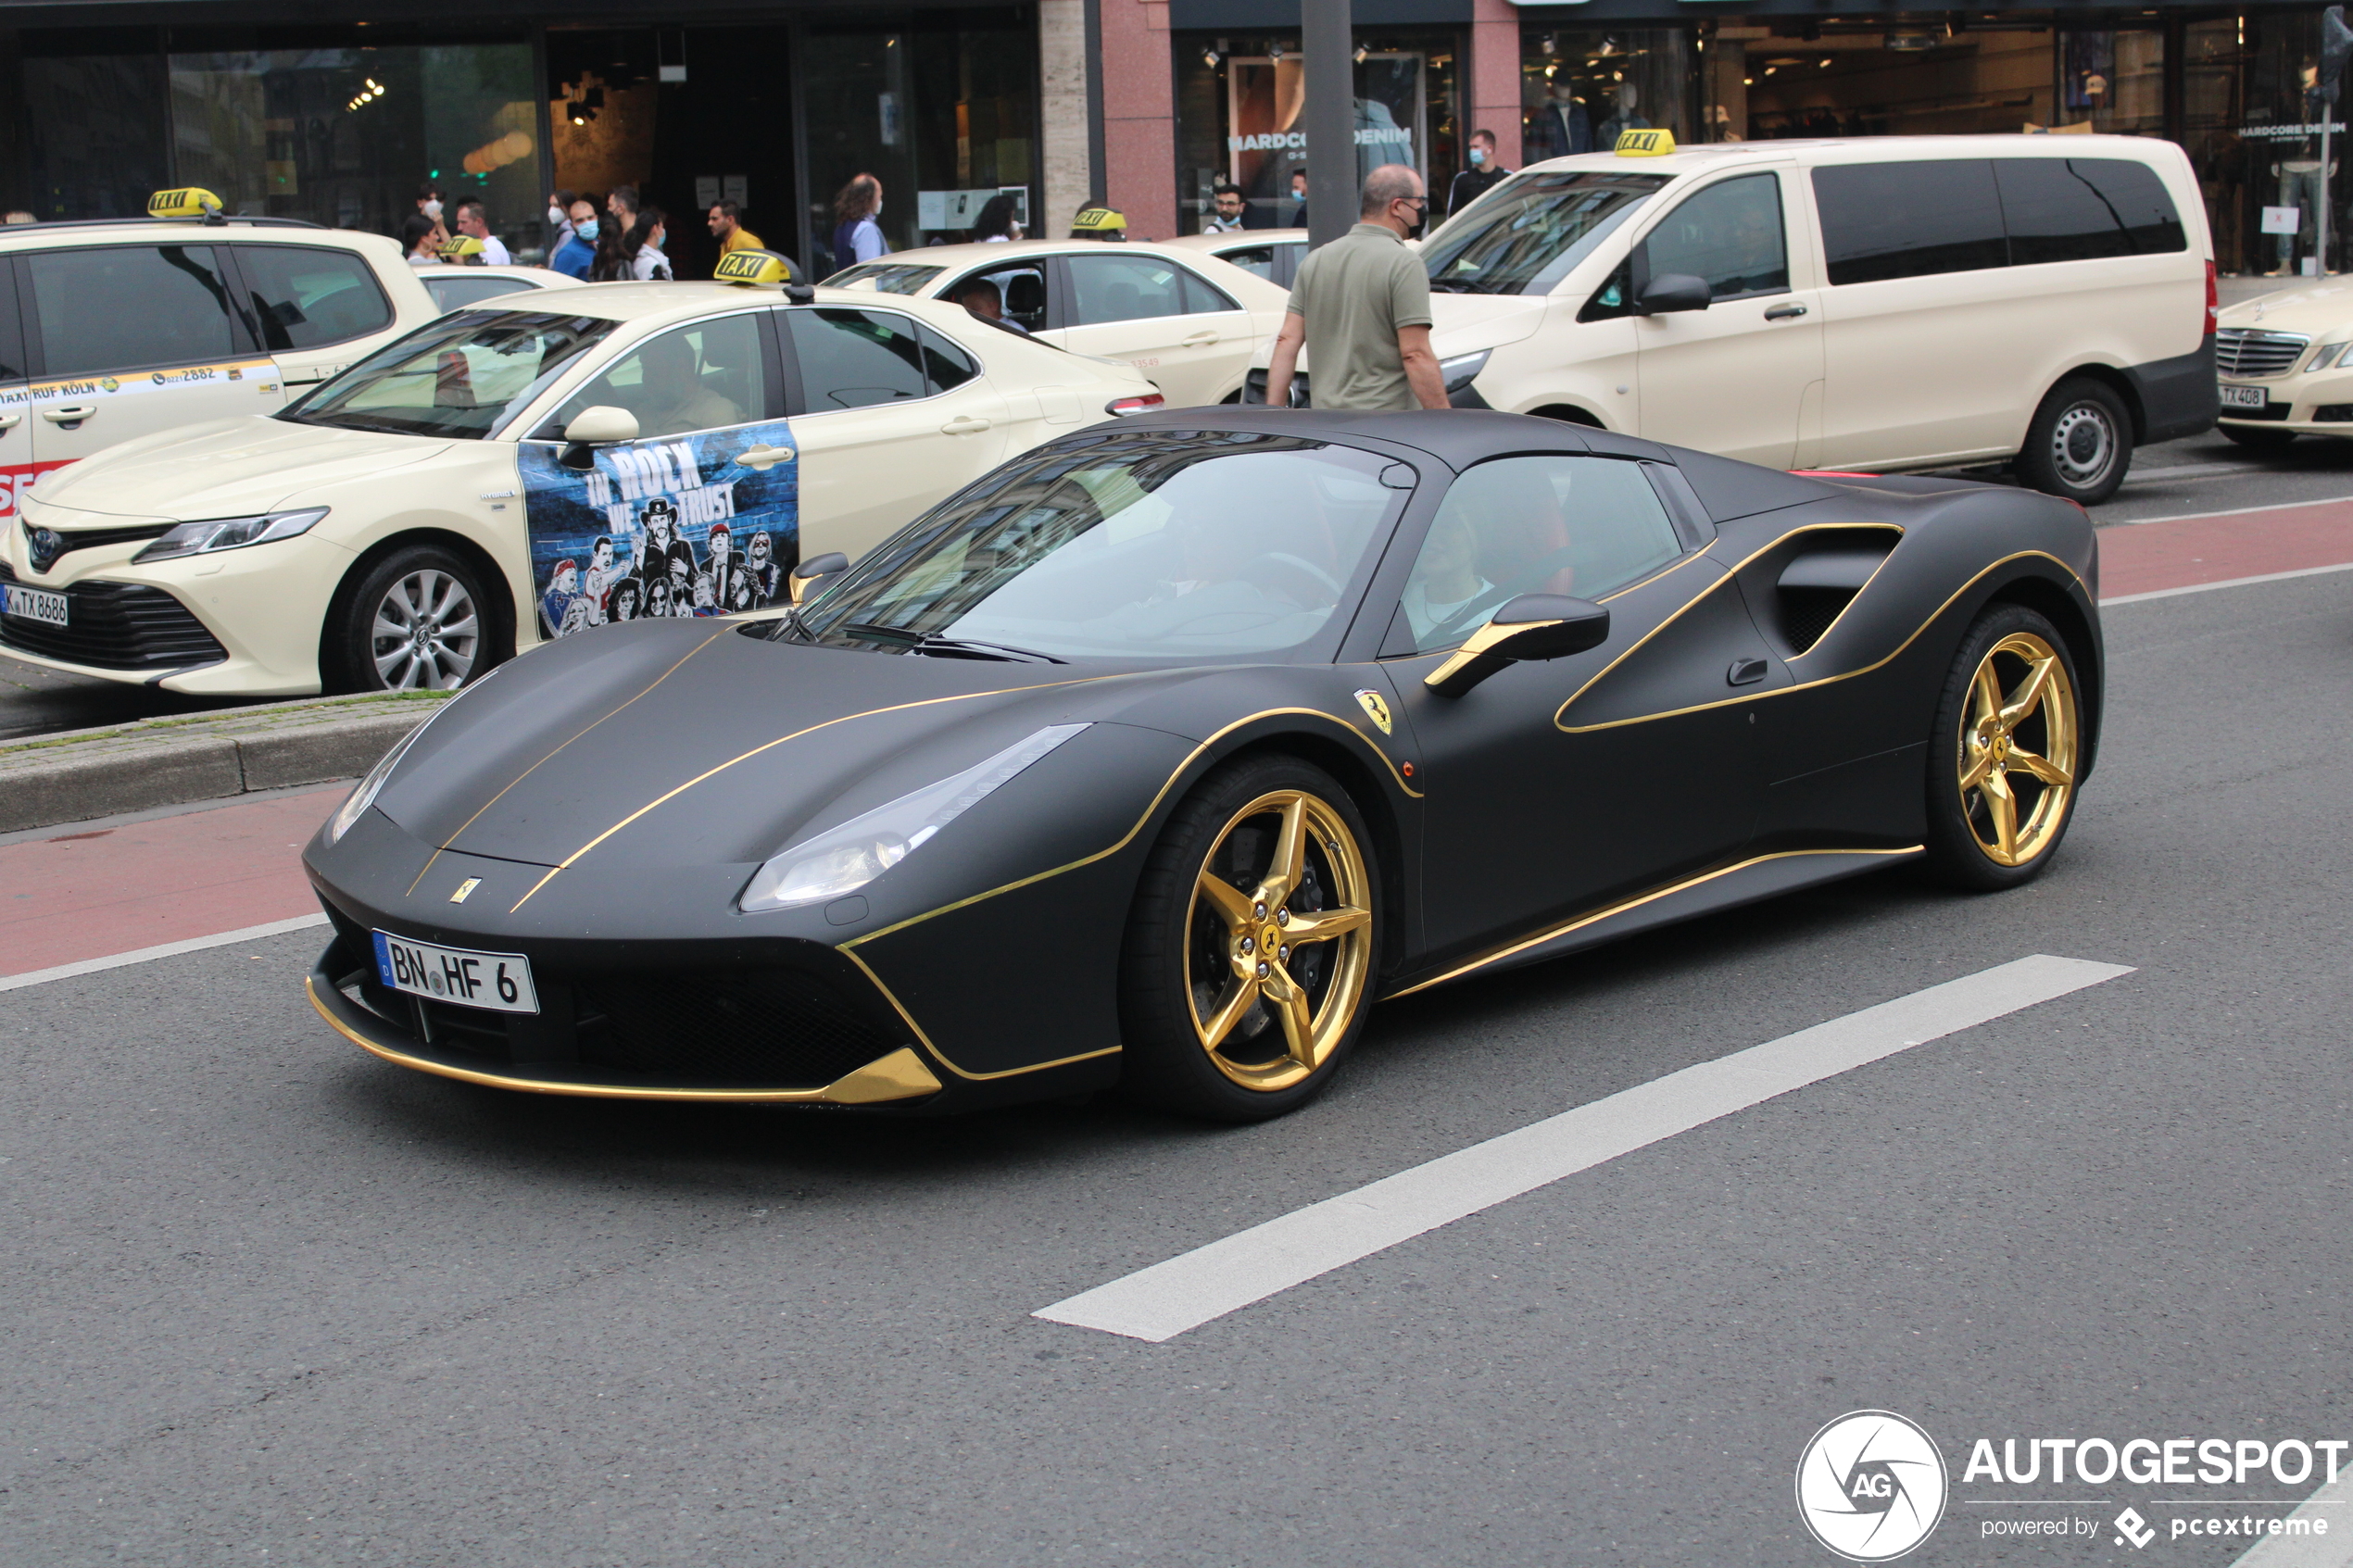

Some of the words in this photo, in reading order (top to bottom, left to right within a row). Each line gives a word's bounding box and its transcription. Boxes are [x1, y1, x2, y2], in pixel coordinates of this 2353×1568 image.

[2239, 125, 2303, 137] HARDCORE
[2305, 122, 2347, 134] DEIM
[1227, 132, 1307, 151] HARDC
[1619, 133, 1657, 149] TAXI
[155, 192, 184, 210] TAXI
[1076, 211, 1108, 225] TAXI
[721, 255, 762, 277] TAXI
[182, 368, 216, 382] 2882
[31, 386, 57, 399] RUF
[60, 381, 96, 396] KÖLN
[2224, 388, 2236, 403] TX
[2238, 389, 2259, 405] 408
[610, 442, 701, 499] ROCK
[481, 491, 511, 500] HYBRID
[586, 471, 610, 507] IN
[608, 503, 636, 535] WE
[676, 483, 735, 525] TRUST
[6, 588, 14, 611] K
[20, 591, 35, 616] TX
[38, 595, 66, 621] 8686
[390, 942, 429, 990] BN
[440, 954, 482, 998] HF
[497, 961, 518, 1003] 6
